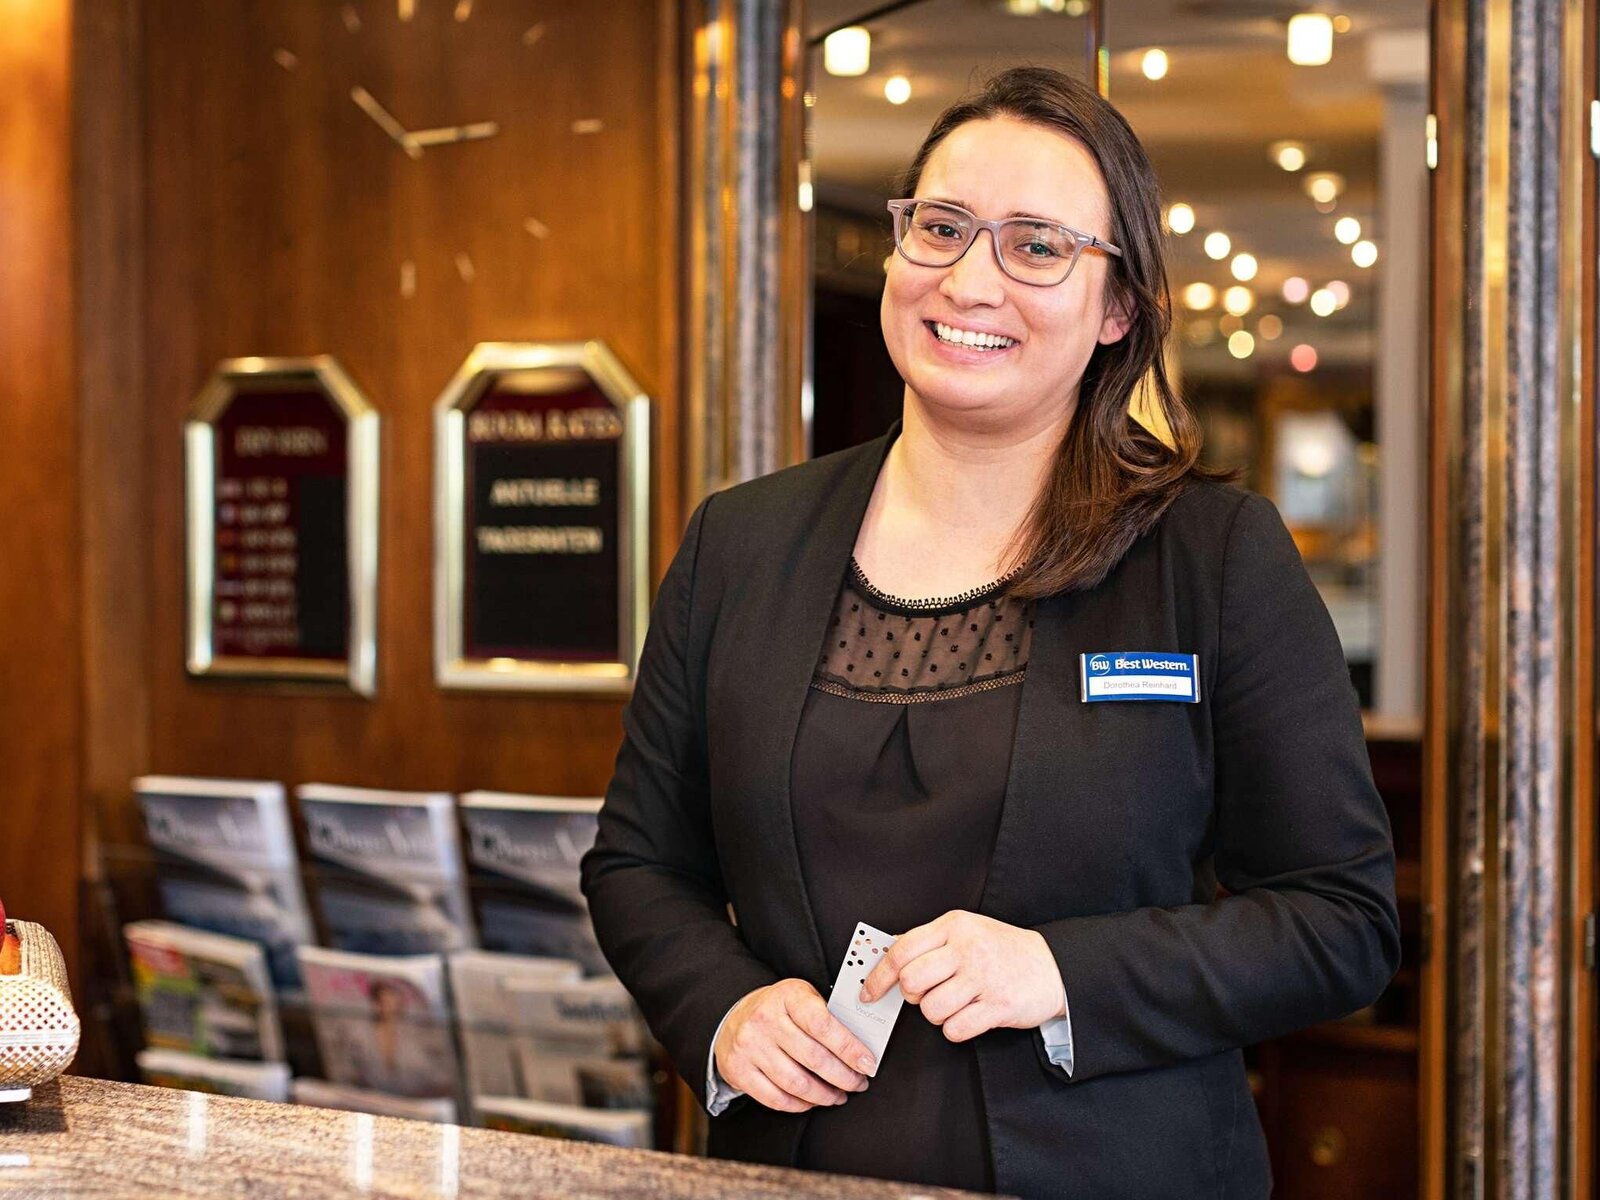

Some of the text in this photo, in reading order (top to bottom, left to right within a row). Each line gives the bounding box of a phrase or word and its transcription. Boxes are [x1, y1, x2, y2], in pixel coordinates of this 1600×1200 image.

[1091, 659, 1110, 671] BW
[1115, 659, 1141, 670] Best
[1103, 681, 1177, 690] Dorothea Reinhard
